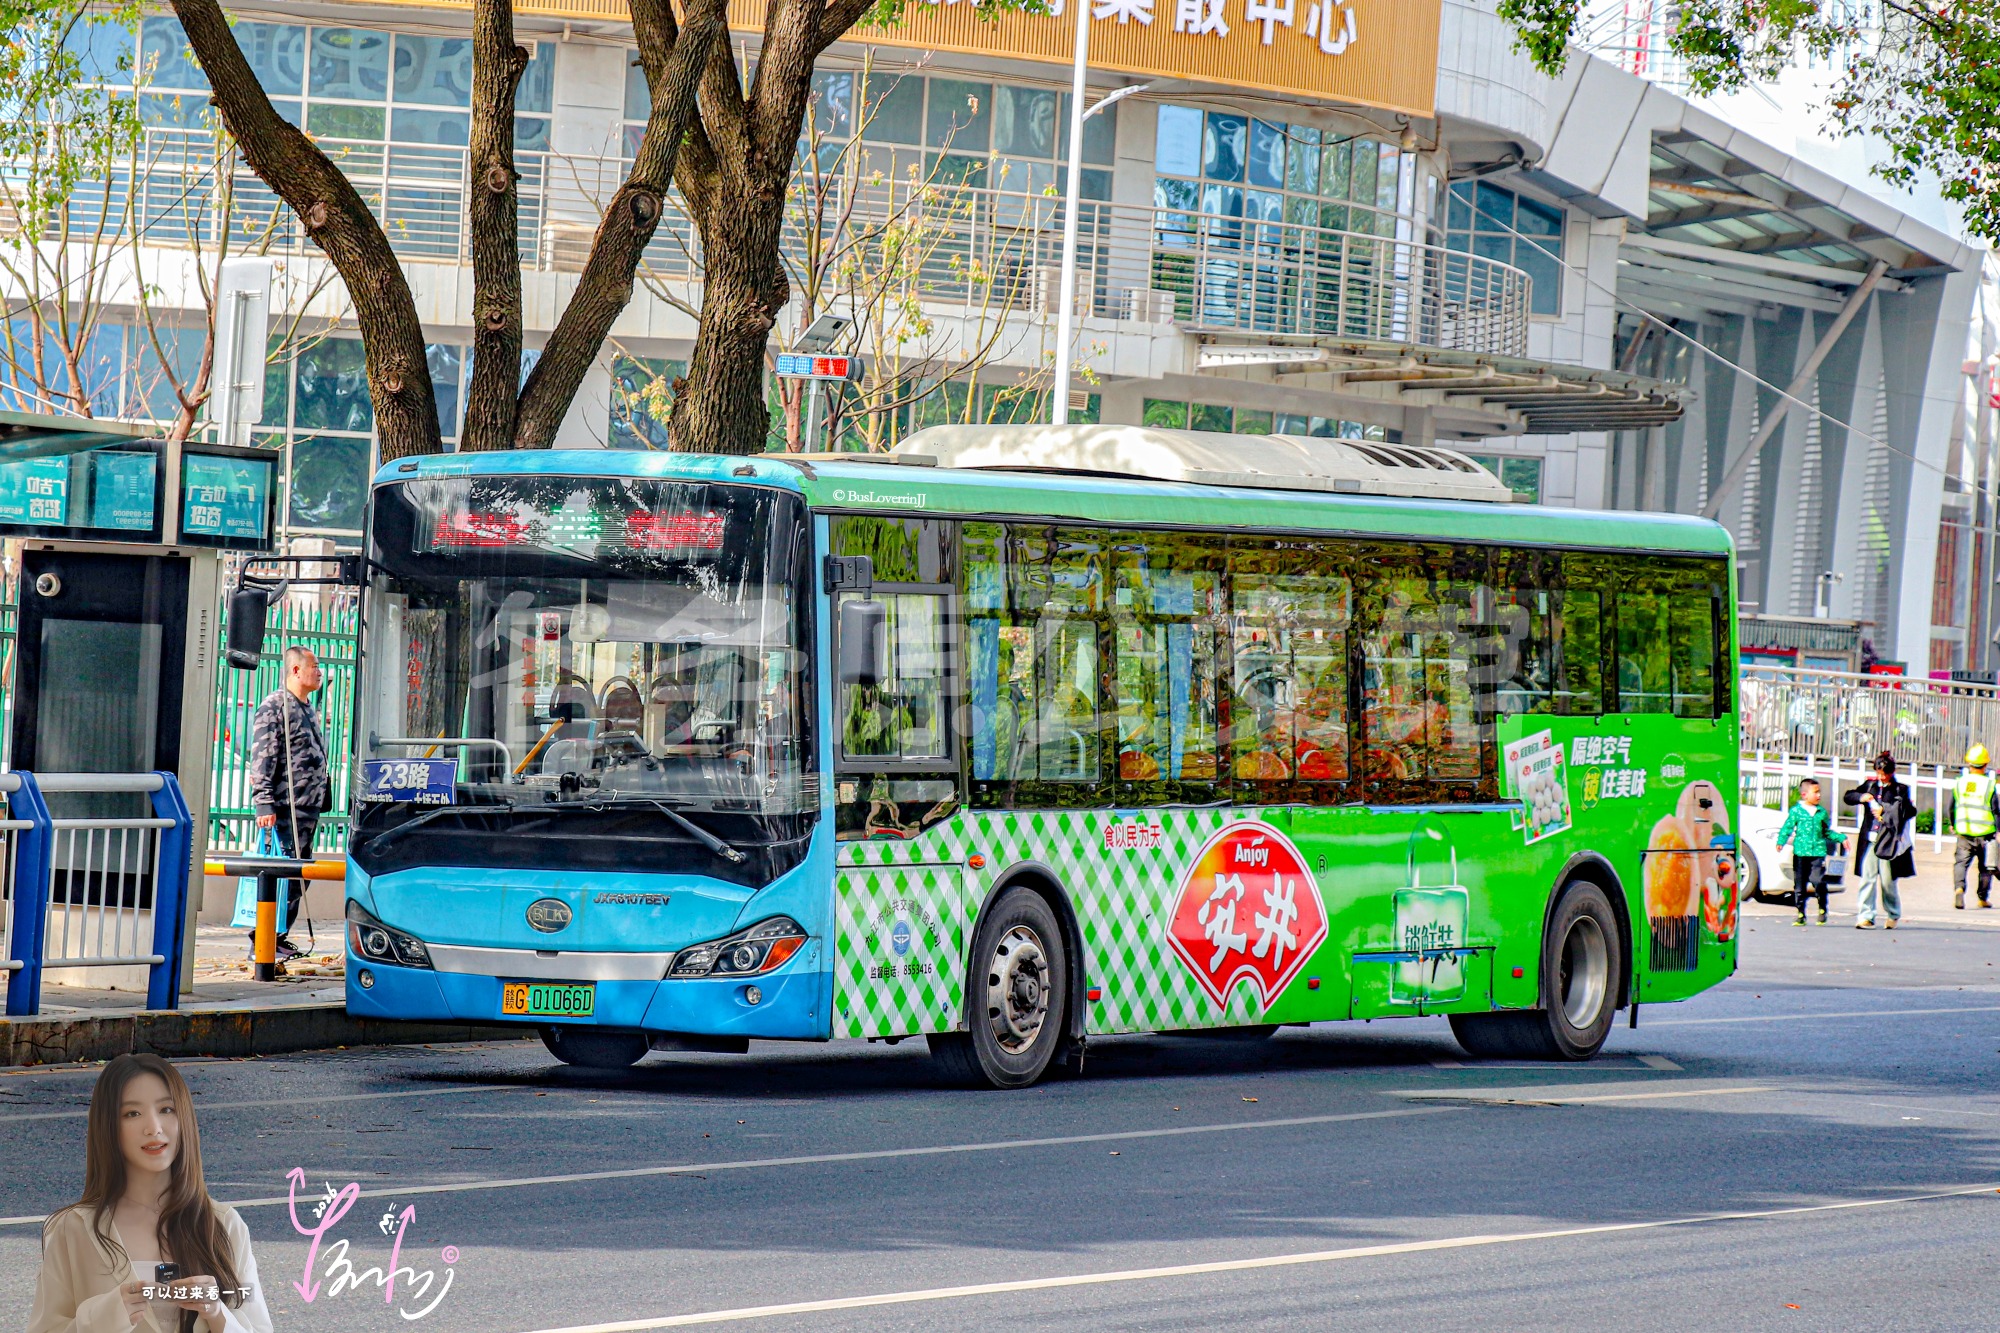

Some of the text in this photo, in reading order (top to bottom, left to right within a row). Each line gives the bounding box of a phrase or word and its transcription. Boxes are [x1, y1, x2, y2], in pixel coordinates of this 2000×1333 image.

[187, 482, 227, 503] 广告位
[190, 505, 222, 527] 招商
[1570, 736, 1633, 767] 隔绝空气
[378, 762, 430, 790] 23路
[1103, 824, 1162, 849] 食以民为天
[1235, 835, 1269, 867] Anjoy
[531, 905, 569, 923] BLK
[1198, 872, 1298, 974] 安井
